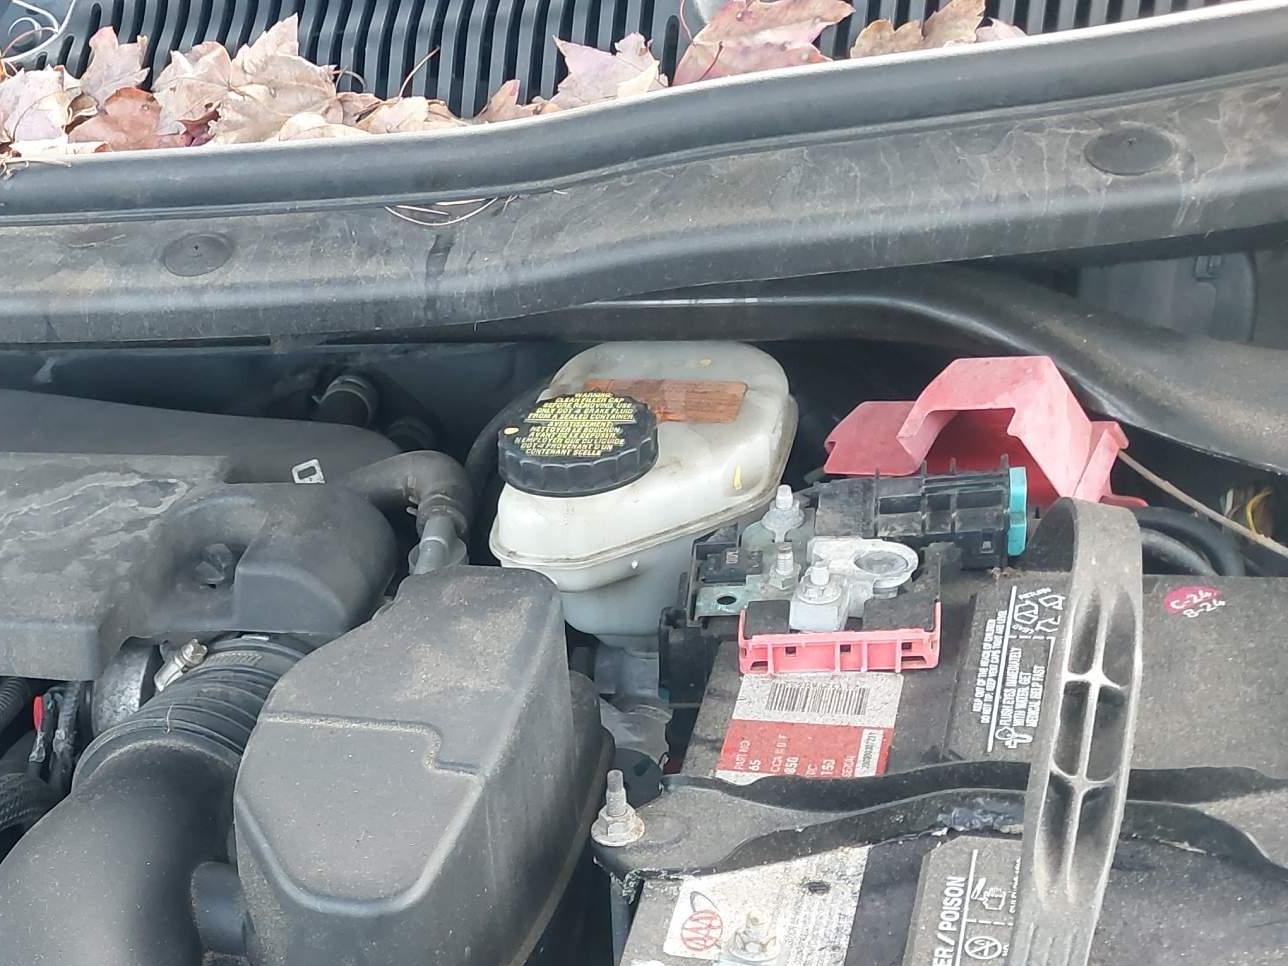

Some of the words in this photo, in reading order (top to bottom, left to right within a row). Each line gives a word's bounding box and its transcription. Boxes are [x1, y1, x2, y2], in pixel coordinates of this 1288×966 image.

[1005, 647, 1022, 687] IMMEDIATELY
[1032, 663, 1046, 682] FAST
[1018, 671, 1032, 686] GET
[1002, 687, 1017, 705] EYES
[999, 704, 1014, 727] FLUSH
[748, 759, 762, 772] 65
